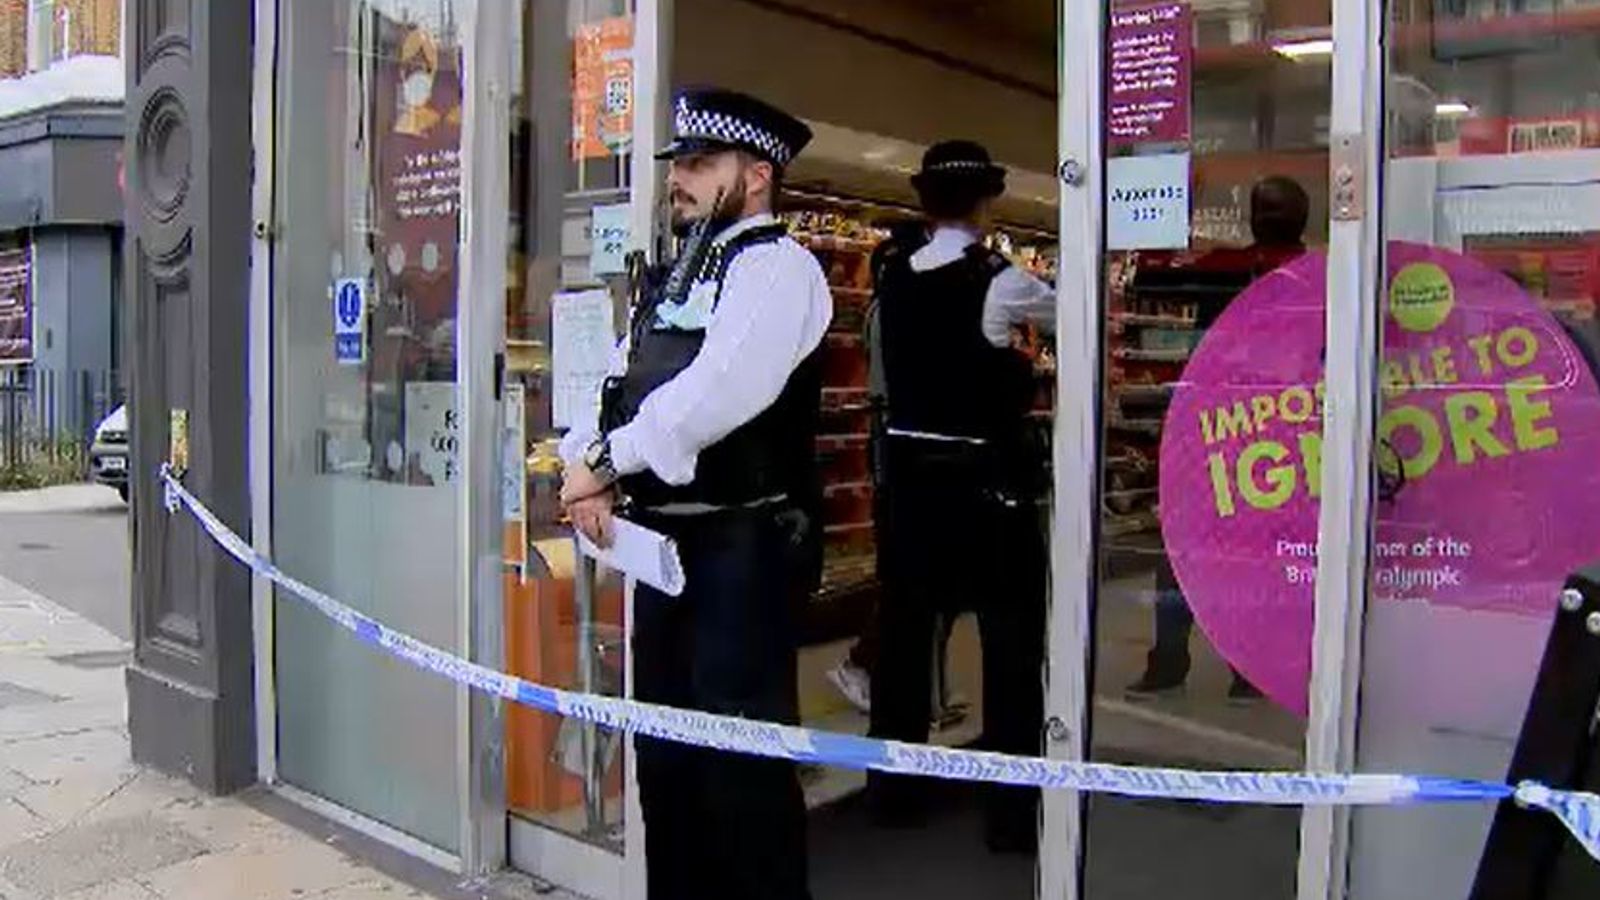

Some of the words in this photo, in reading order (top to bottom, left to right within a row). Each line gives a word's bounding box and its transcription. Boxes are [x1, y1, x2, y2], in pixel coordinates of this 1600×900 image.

[1469, 326, 1538, 377] TO
[1412, 536, 1434, 557] of
[1437, 536, 1472, 556] the
